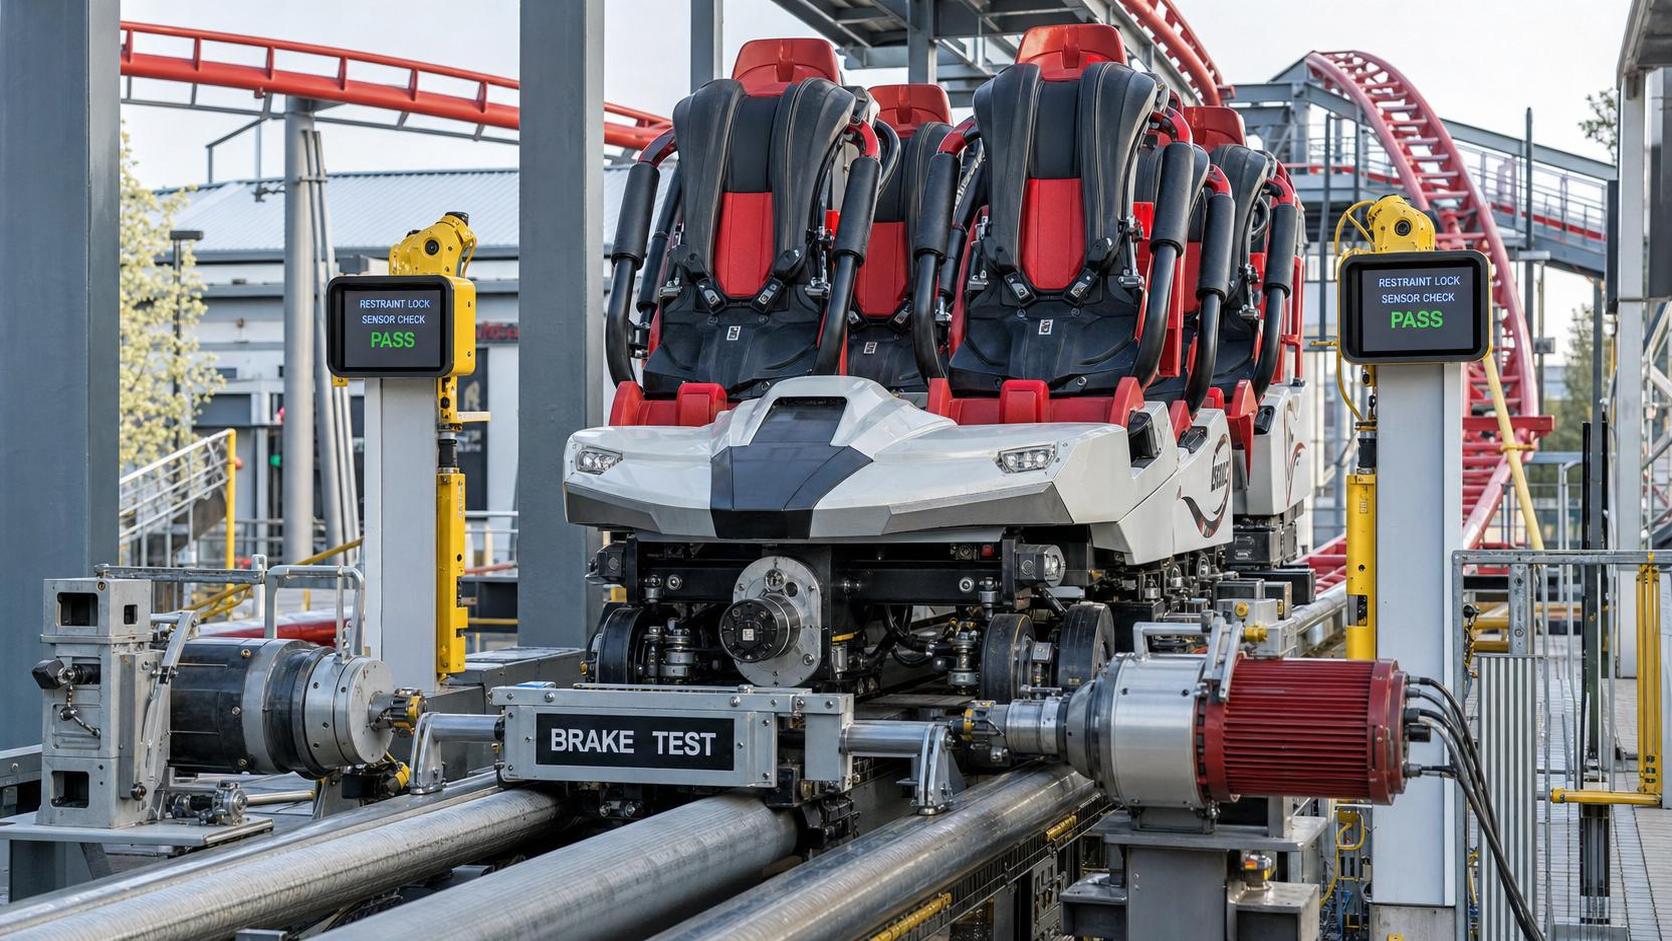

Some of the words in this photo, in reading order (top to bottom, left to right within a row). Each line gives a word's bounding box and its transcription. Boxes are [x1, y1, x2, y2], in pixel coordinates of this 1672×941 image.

[1378, 276, 1431, 287] RESTRAINT
[1434, 275, 1460, 285] LOCK
[1381, 293, 1420, 303] SENSOR
[1423, 292, 1455, 302] CHECK
[359, 299, 405, 309] RESTRAINT
[408, 299, 430, 309] LOCK
[361, 314, 395, 324] SENSOR
[397, 314, 425, 324] CHECK
[1391, 310, 1443, 328] PASS
[370, 331, 415, 348] PASS
[551, 728, 634, 754] BRAKE
[652, 731, 716, 756] TEST
